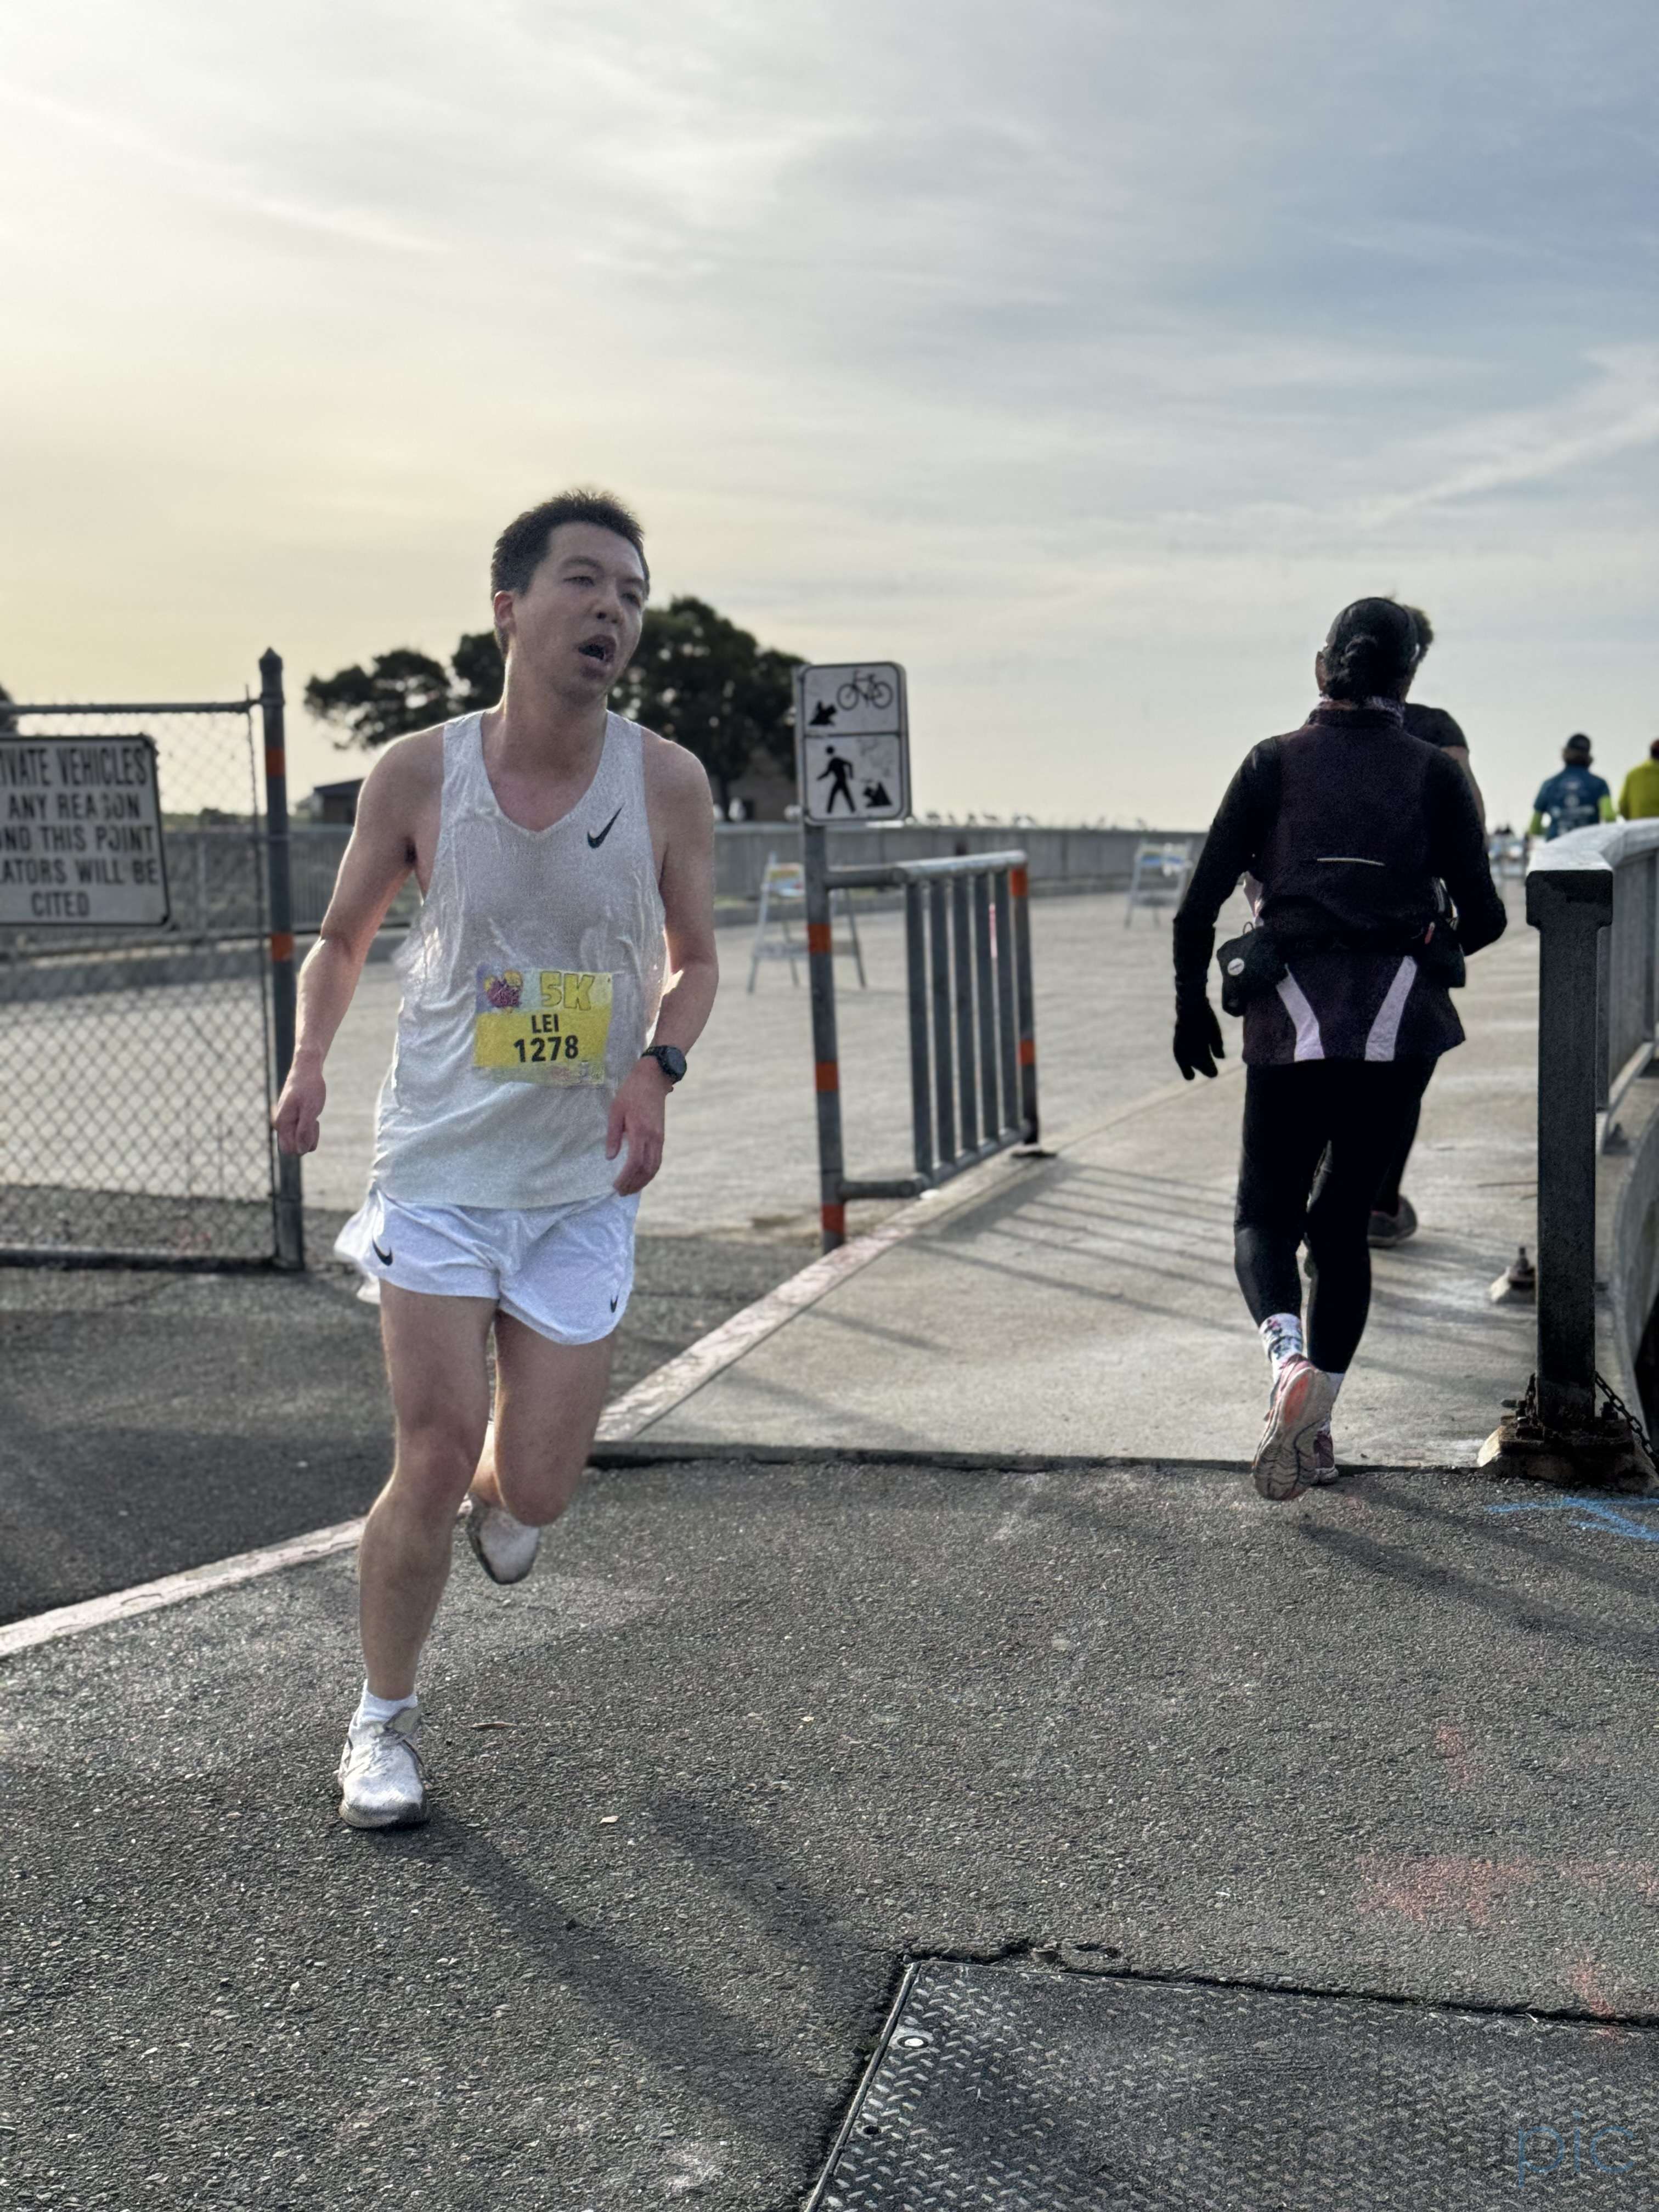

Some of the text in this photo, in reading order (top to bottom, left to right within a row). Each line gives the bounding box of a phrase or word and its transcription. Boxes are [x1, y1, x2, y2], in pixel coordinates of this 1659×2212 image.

[0, 748, 148, 786] IVATE VEHICLES
[9, 793, 140, 820] ANY REASON
[0, 826, 153, 851] ND THIS POINT
[0, 859, 159, 885] ATORS WILL BE
[31, 891, 90, 917] CITED
[540, 970, 595, 1011] 5K
[531, 1014, 560, 1034] LEI
[514, 1035, 579, 1063] 1278
